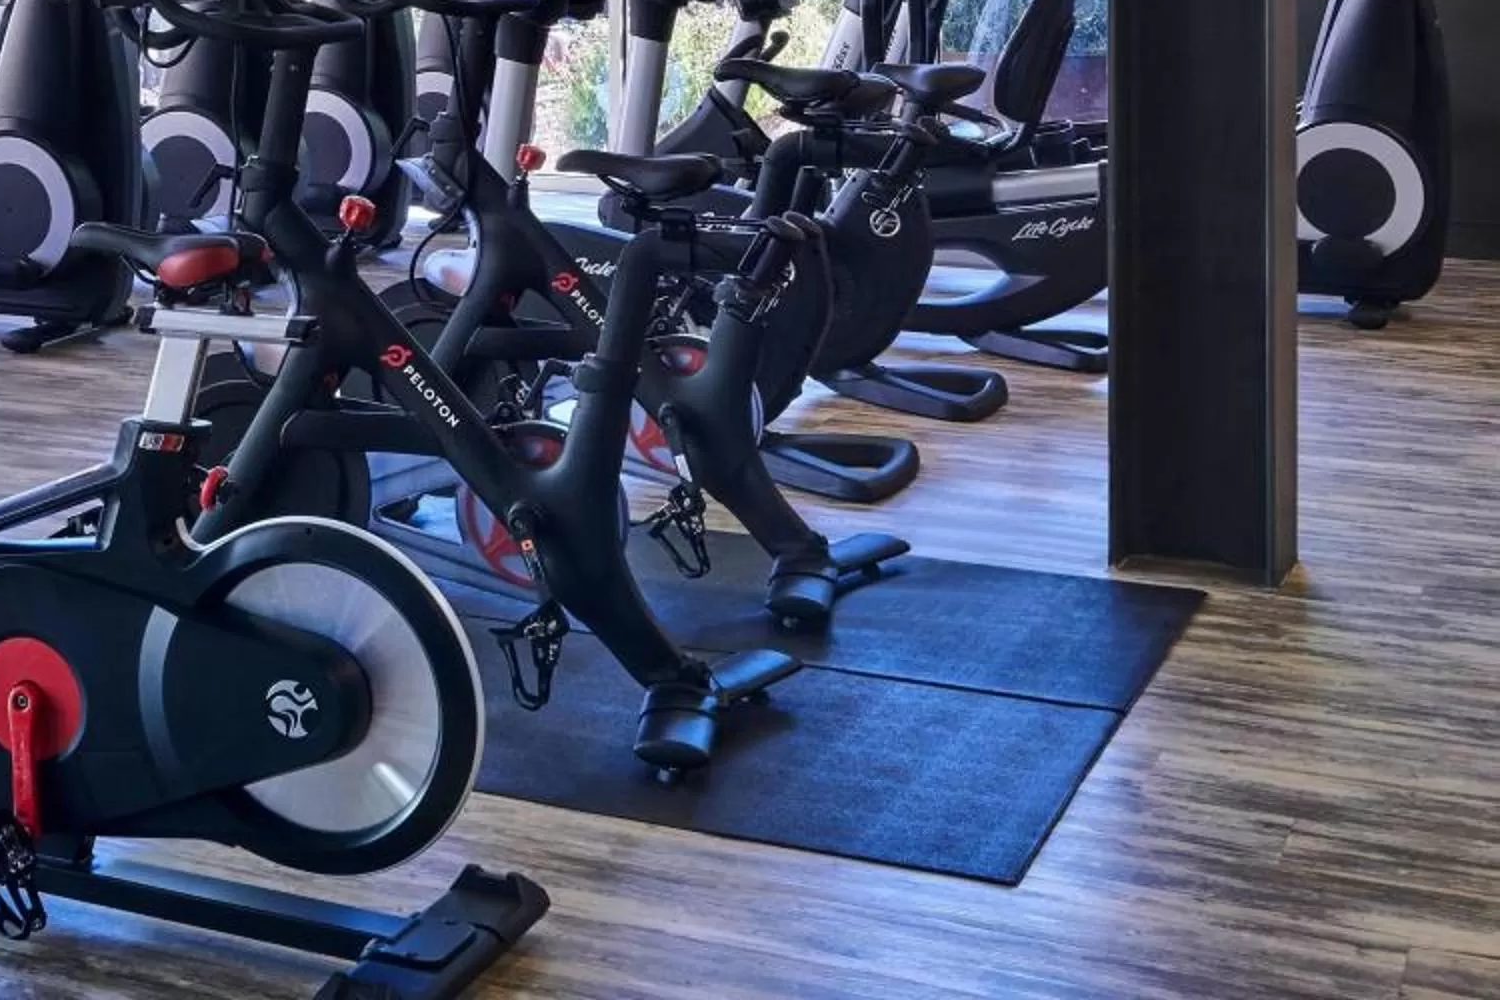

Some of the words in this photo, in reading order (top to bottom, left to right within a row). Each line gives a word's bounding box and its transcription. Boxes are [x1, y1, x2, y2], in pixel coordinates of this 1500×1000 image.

[1011, 221, 1049, 241] Life
[570, 289, 605, 331] PELOT
[402, 364, 461, 429] PELOTON
